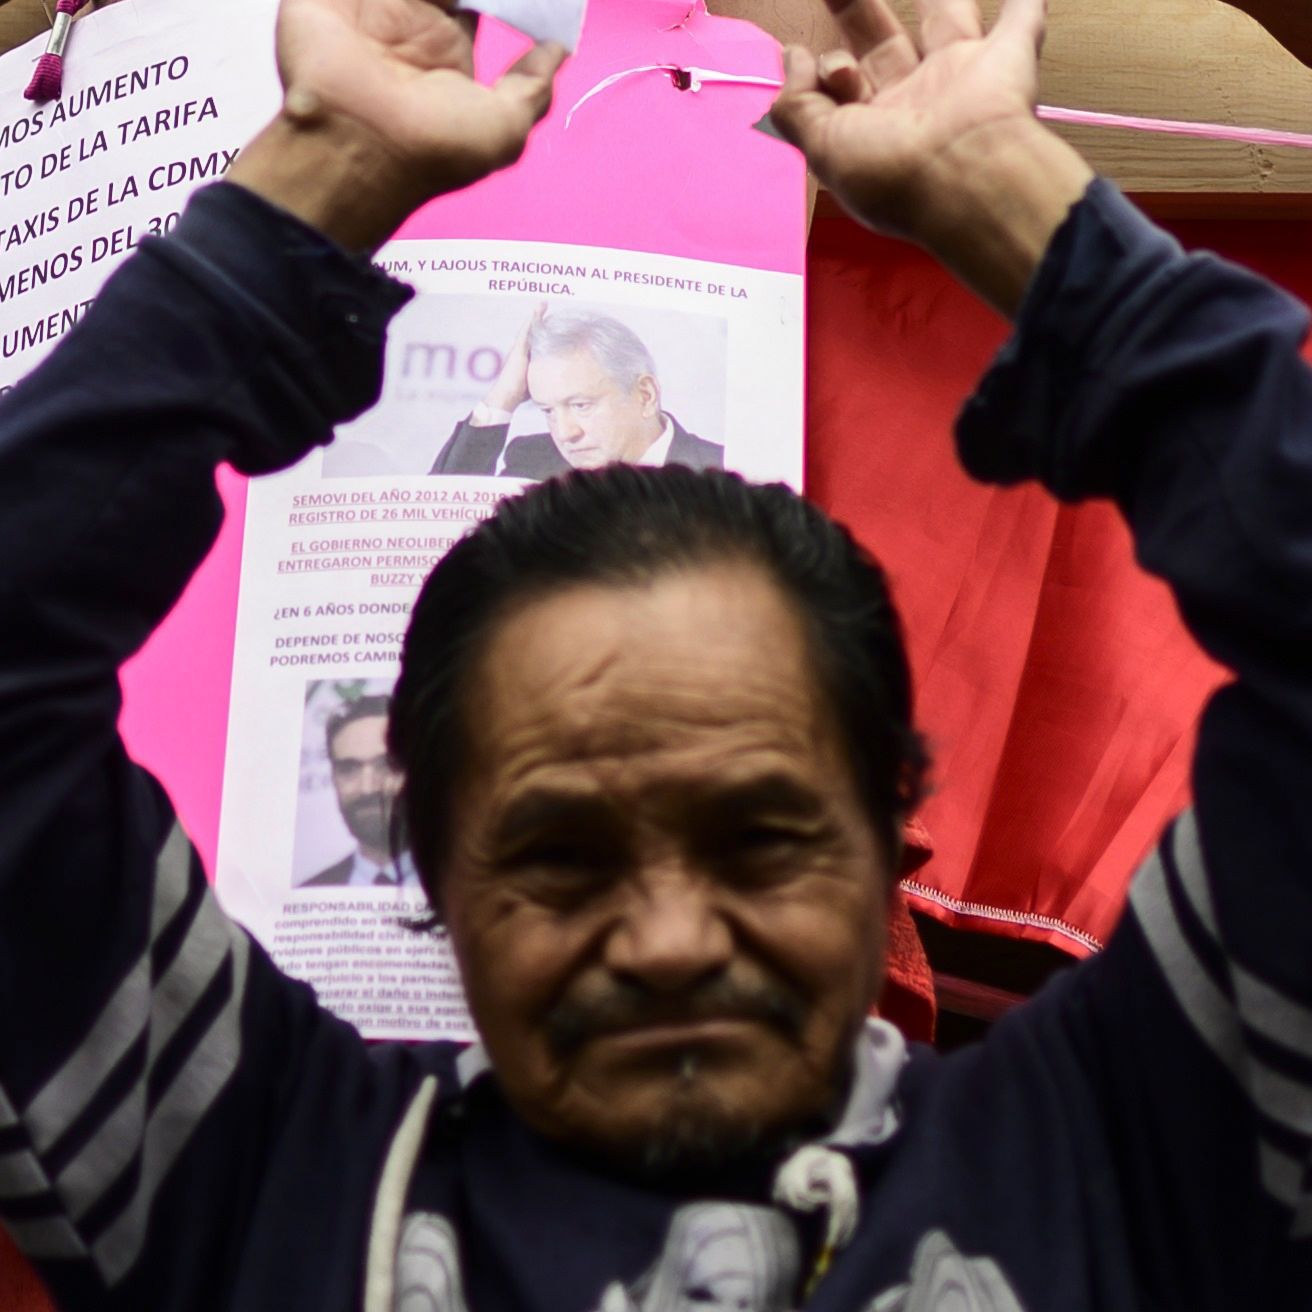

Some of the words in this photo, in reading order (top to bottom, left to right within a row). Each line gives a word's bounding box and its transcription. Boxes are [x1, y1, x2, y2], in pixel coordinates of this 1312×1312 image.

[49, 56, 189, 127] AUMENTO
[40, 145, 71, 179] DE
[78, 131, 108, 161] LA
[117, 97, 219, 145] TARIFA
[67, 188, 98, 223] DE
[107, 176, 139, 205] LA
[147, 148, 240, 191] CDMX
[91, 226, 136, 263] DEL
[418, 260, 426, 271] Y
[431, 259, 487, 272] LAJOUS
[492, 260, 586, 277] TRAICIONAN
[591, 268, 609, 280] AL
[614, 270, 702, 292] PRESIDENTE
[707, 283, 726, 296] DE
[730, 287, 748, 299] LA
[489, 278, 575, 296] REPÚBLICA.
[293, 492, 347, 506] SEMOVI
[351, 492, 375, 504] DEL
[380, 489, 411, 502] AÑO
[415, 490, 448, 502] 2012
[452, 491, 470, 502] AL
[289, 509, 356, 524] REGISTRO
[360, 509, 377, 521] DE
[382, 508, 398, 520] 26
[402, 508, 427, 519] MIL
[291, 541, 305, 553] EL
[310, 539, 382, 553] GOBIERNO
[387, 537, 456, 550] NEOLIBER
[278, 557, 372, 572] ENTREGARON
[371, 573, 415, 585] BUZZY
[304, 606, 312, 617] 6
[315, 602, 355, 617] AÑOS
[358, 602, 410, 615] DONDE
[275, 636, 338, 649] DEPENDE
[343, 634, 360, 646] DE
[270, 652, 351, 667] PODREMOS
[282, 900, 411, 914] RESPONSABILIDAD
